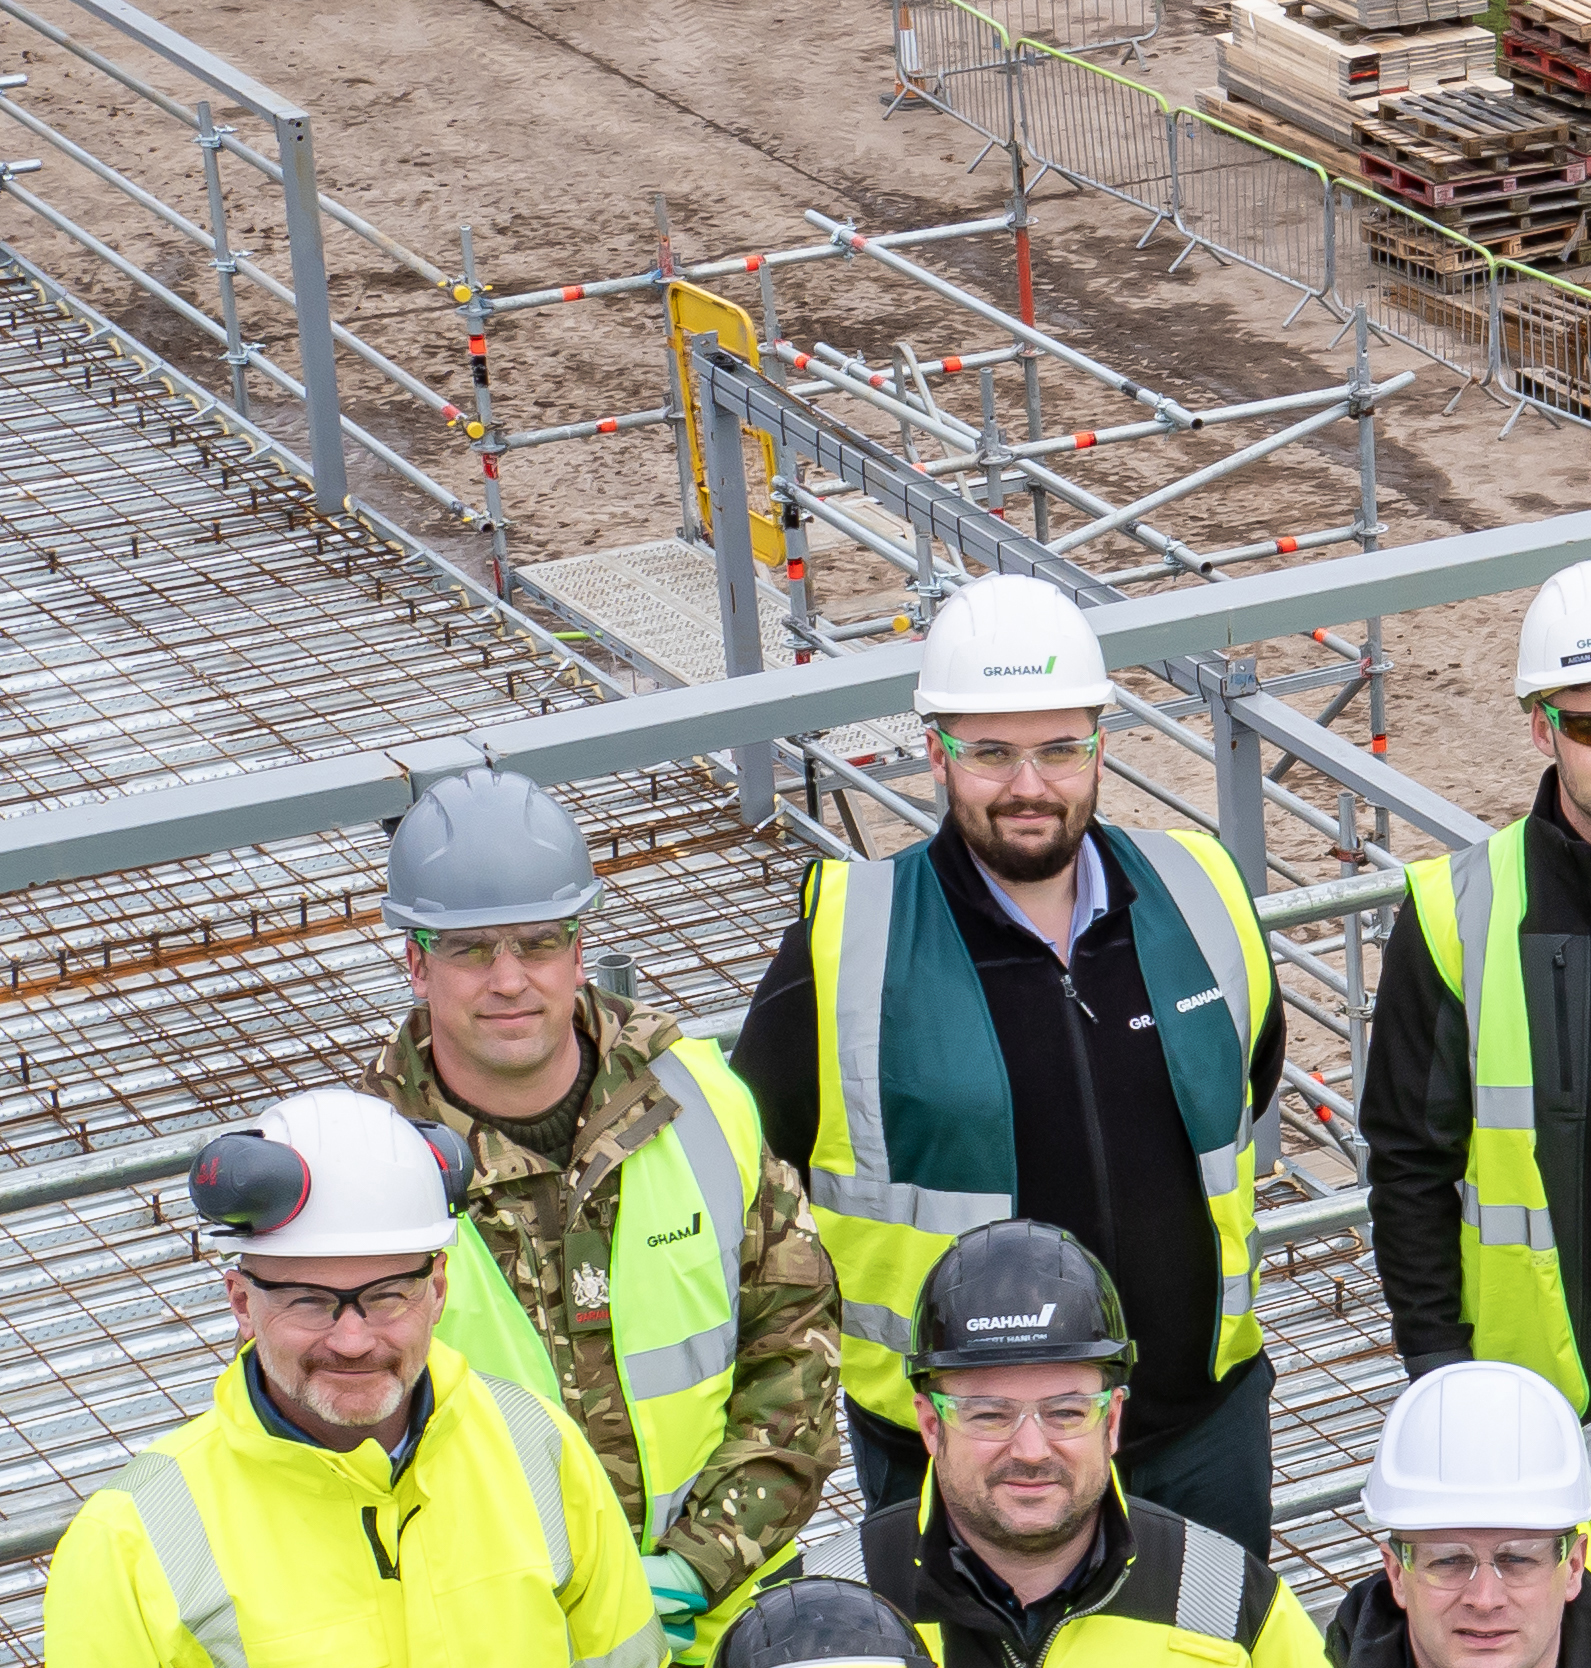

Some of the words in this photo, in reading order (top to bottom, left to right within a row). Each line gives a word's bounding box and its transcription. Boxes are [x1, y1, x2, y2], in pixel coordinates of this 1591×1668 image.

[1567, 655, 1591, 664] AIDAN
[983, 665, 1043, 677] GRAHAM
[966, 1314, 1039, 1332] GRAHAM
